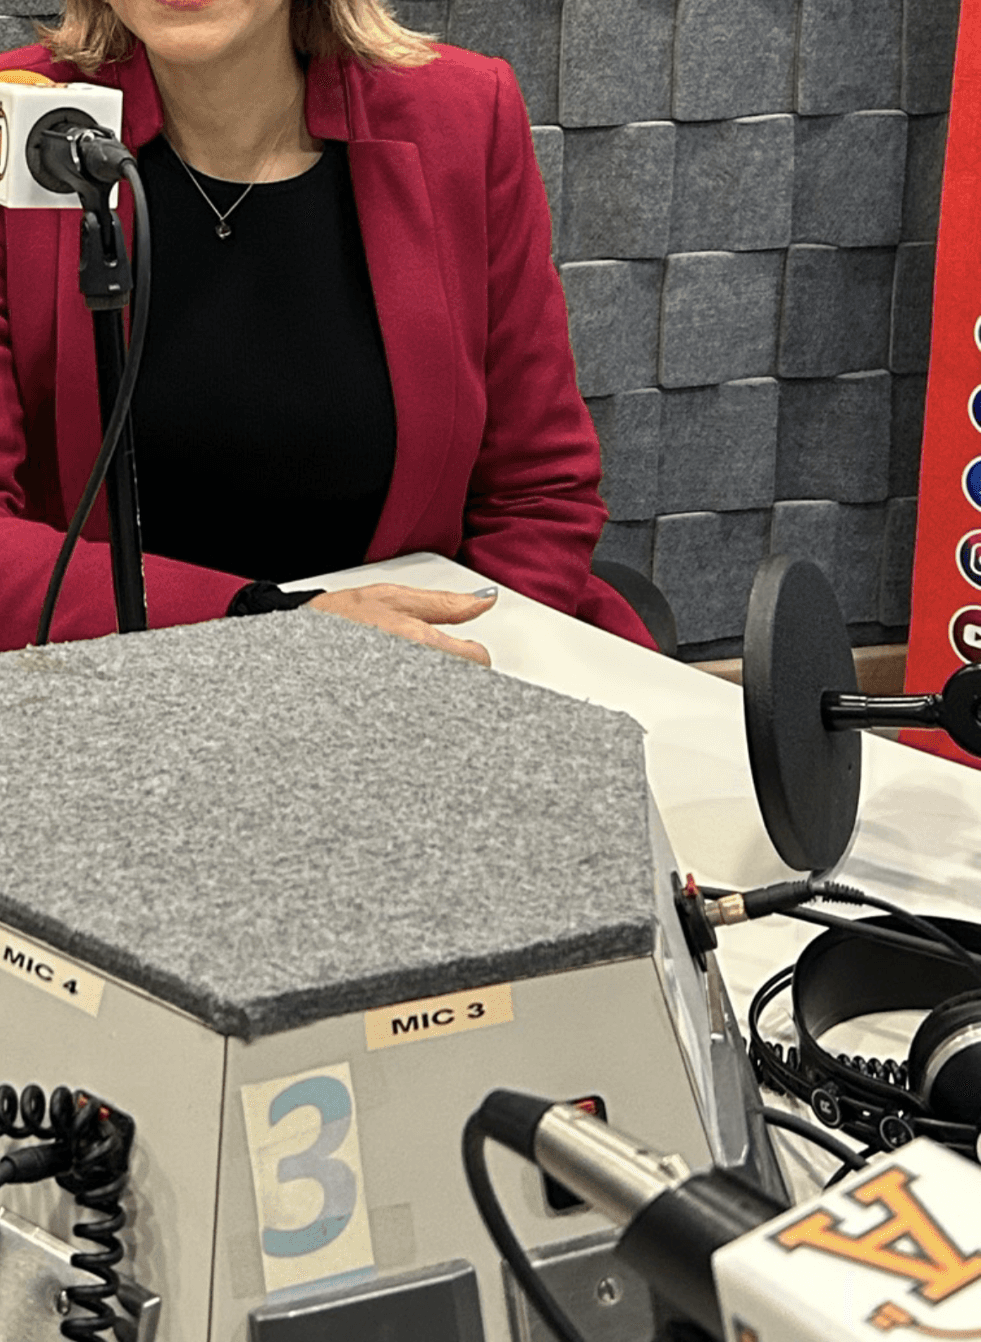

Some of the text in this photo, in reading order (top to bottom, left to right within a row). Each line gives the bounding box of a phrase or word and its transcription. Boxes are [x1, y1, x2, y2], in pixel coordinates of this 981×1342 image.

[3, 945, 79, 995] MIC 4
[391, 1001, 487, 1036] MIC 3
[261, 1074, 358, 1259] 3
[766, 1162, 981, 1306] A
